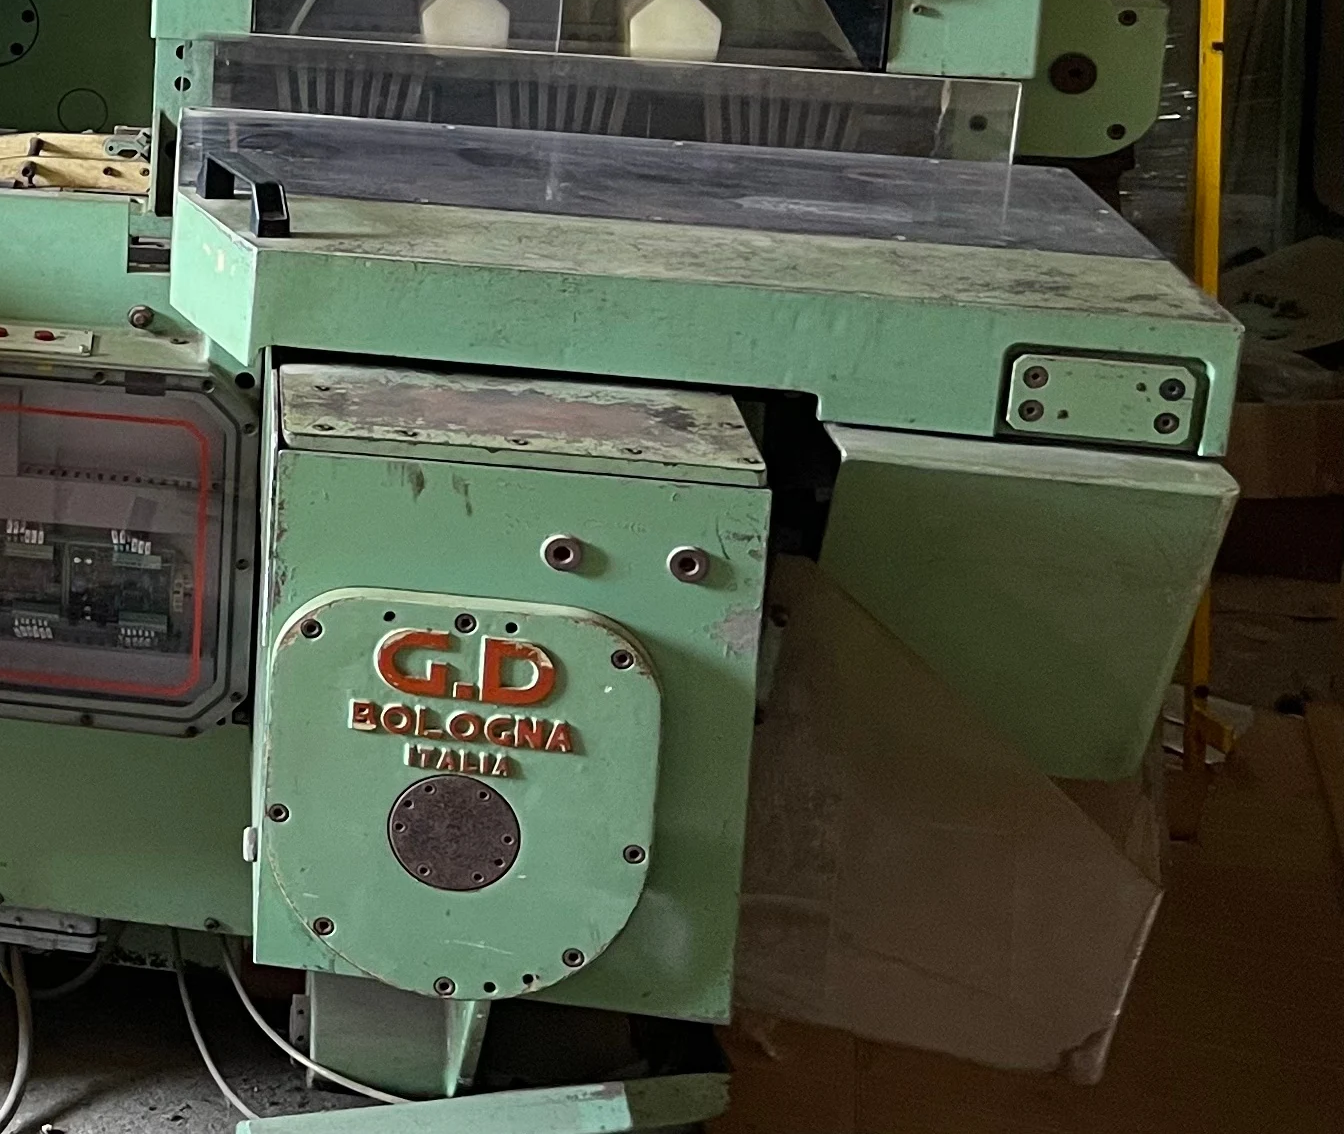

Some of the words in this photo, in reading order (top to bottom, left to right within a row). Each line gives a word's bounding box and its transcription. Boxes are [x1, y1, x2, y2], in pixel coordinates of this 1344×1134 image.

[373, 627, 557, 706] G.D
[348, 698, 574, 753] BOLOGNA
[403, 742, 510, 777] ITALIA
